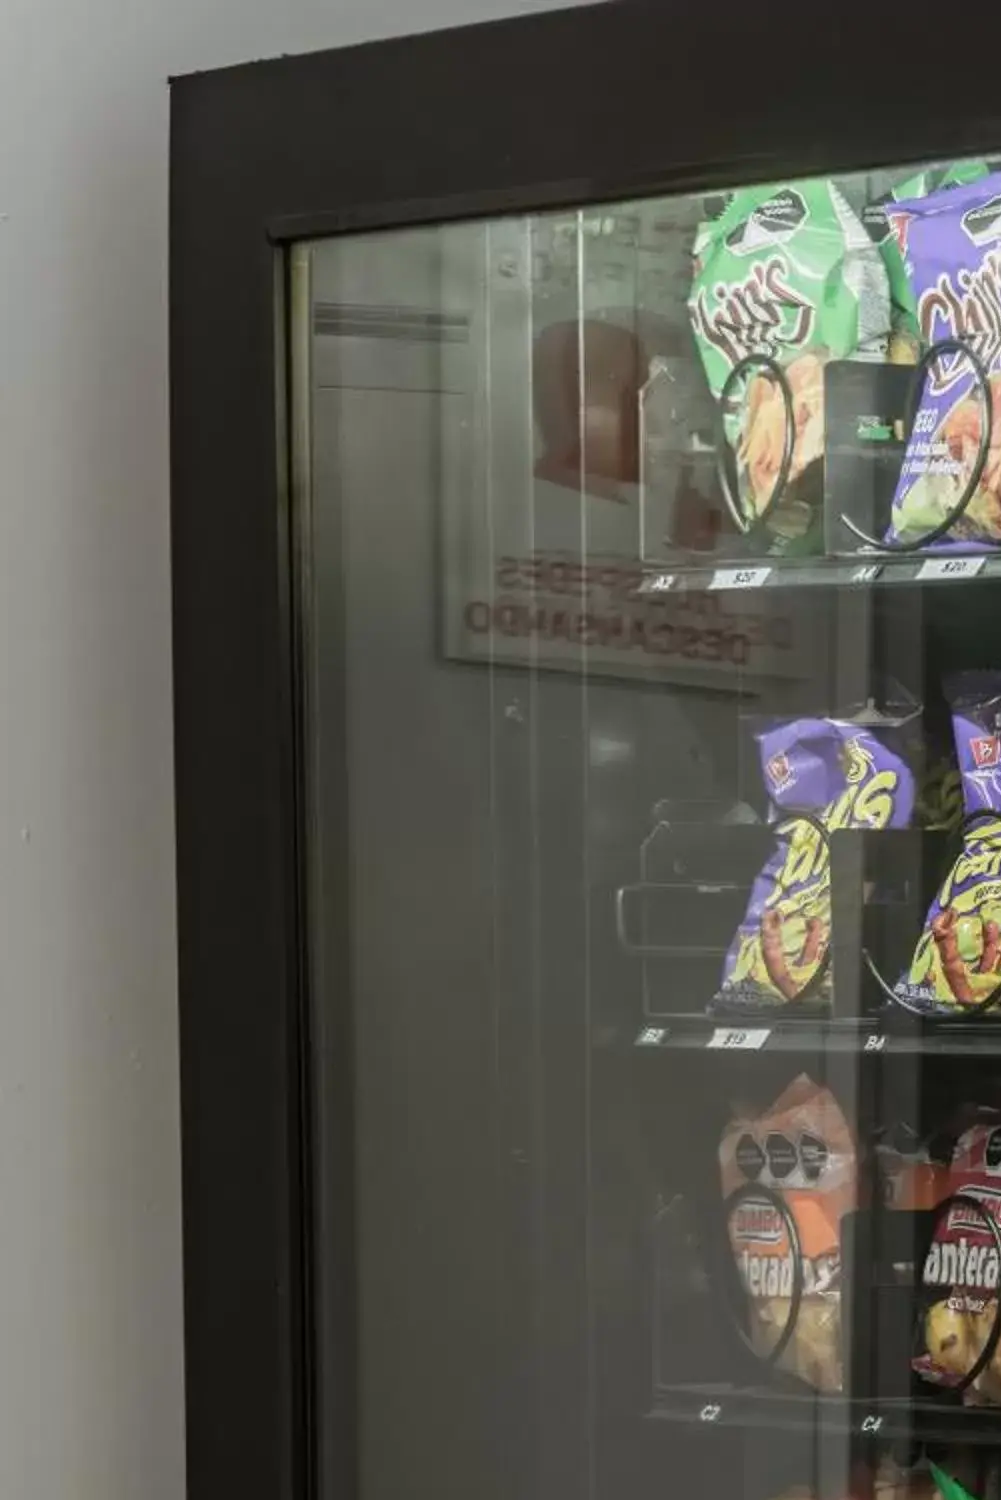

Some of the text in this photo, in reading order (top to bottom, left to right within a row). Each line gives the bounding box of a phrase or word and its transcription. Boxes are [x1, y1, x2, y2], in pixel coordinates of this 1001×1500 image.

[864, 1035, 887, 1050] B4
[700, 1404, 721, 1421] C2
[861, 1415, 884, 1432] C4
